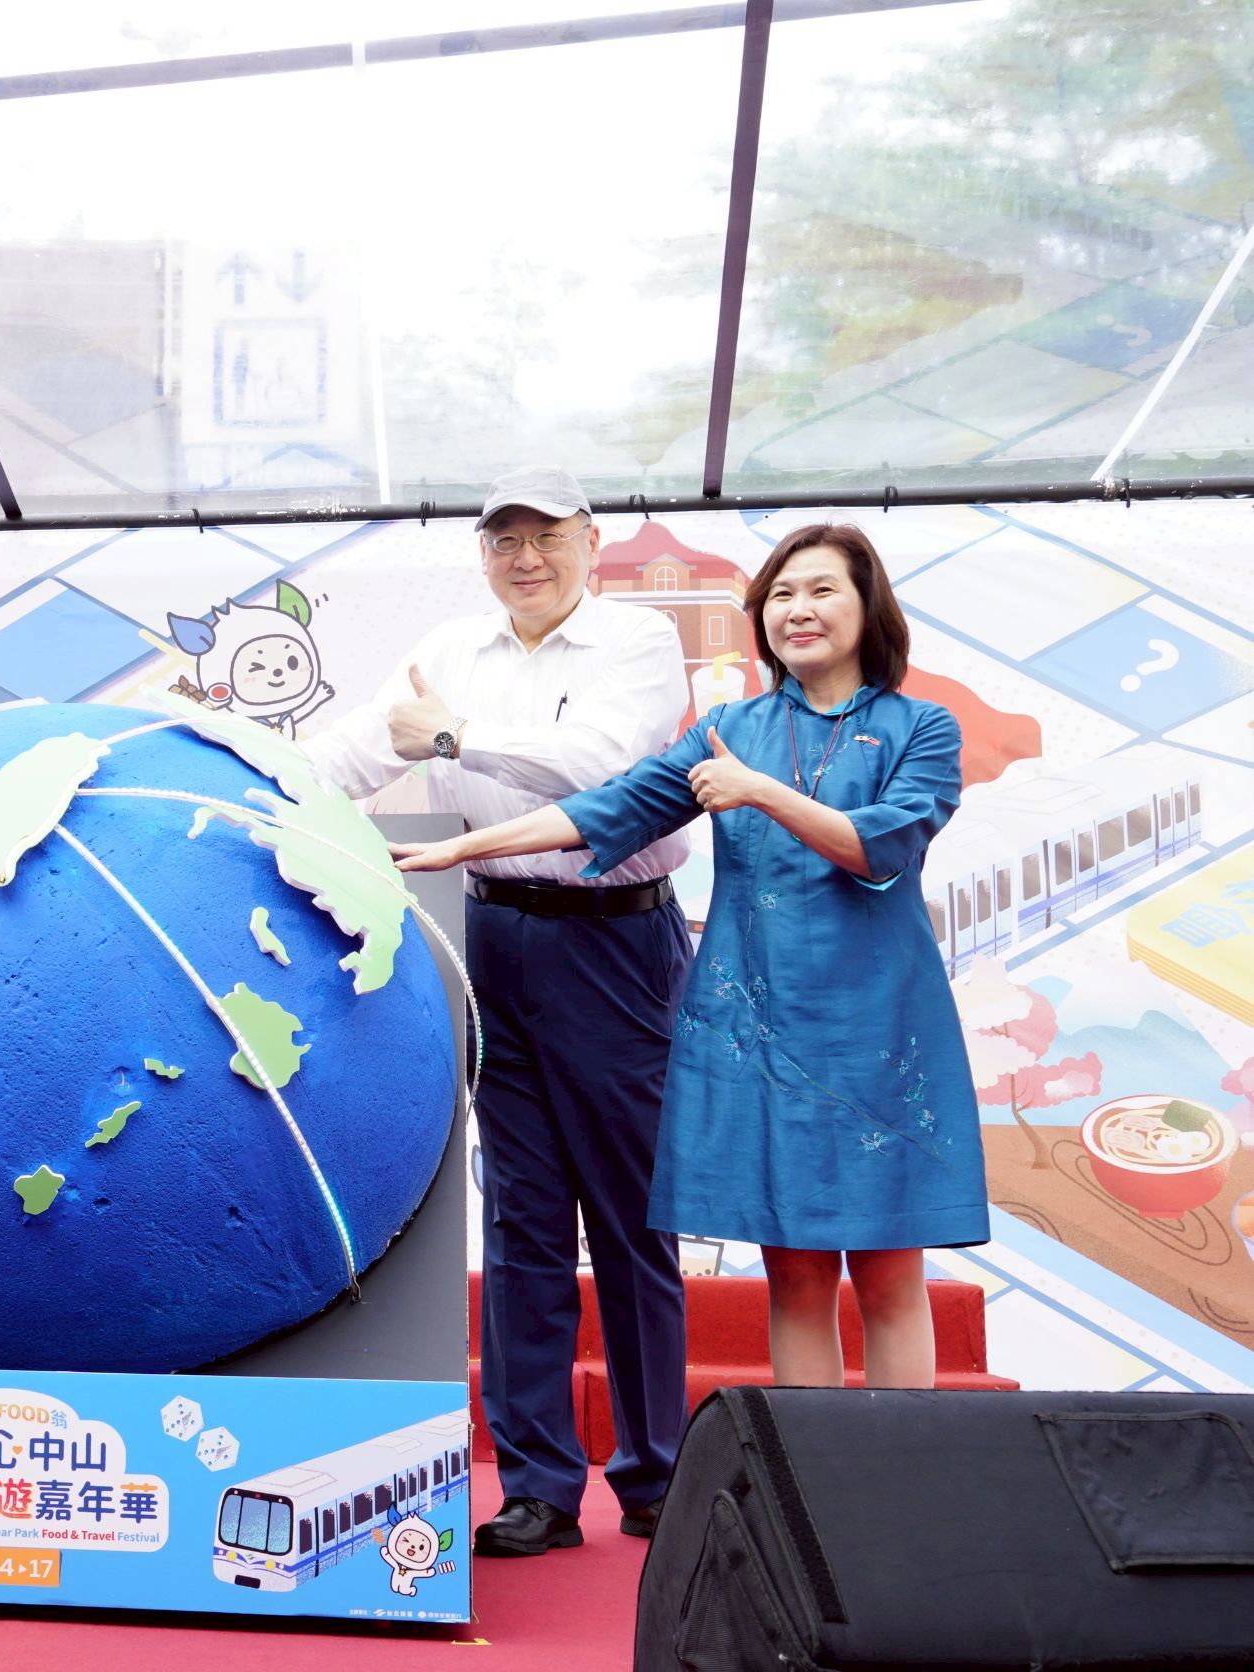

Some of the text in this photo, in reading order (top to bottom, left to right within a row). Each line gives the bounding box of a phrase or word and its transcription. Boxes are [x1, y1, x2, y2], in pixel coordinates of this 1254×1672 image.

[14, 1528, 39, 1539] Park
[42, 1529, 68, 1540] Food
[71, 1530, 79, 1540] &
[82, 1530, 115, 1542] Travel
[117, 1531, 160, 1543] Festival
[29, 1559, 53, 1579] 17
